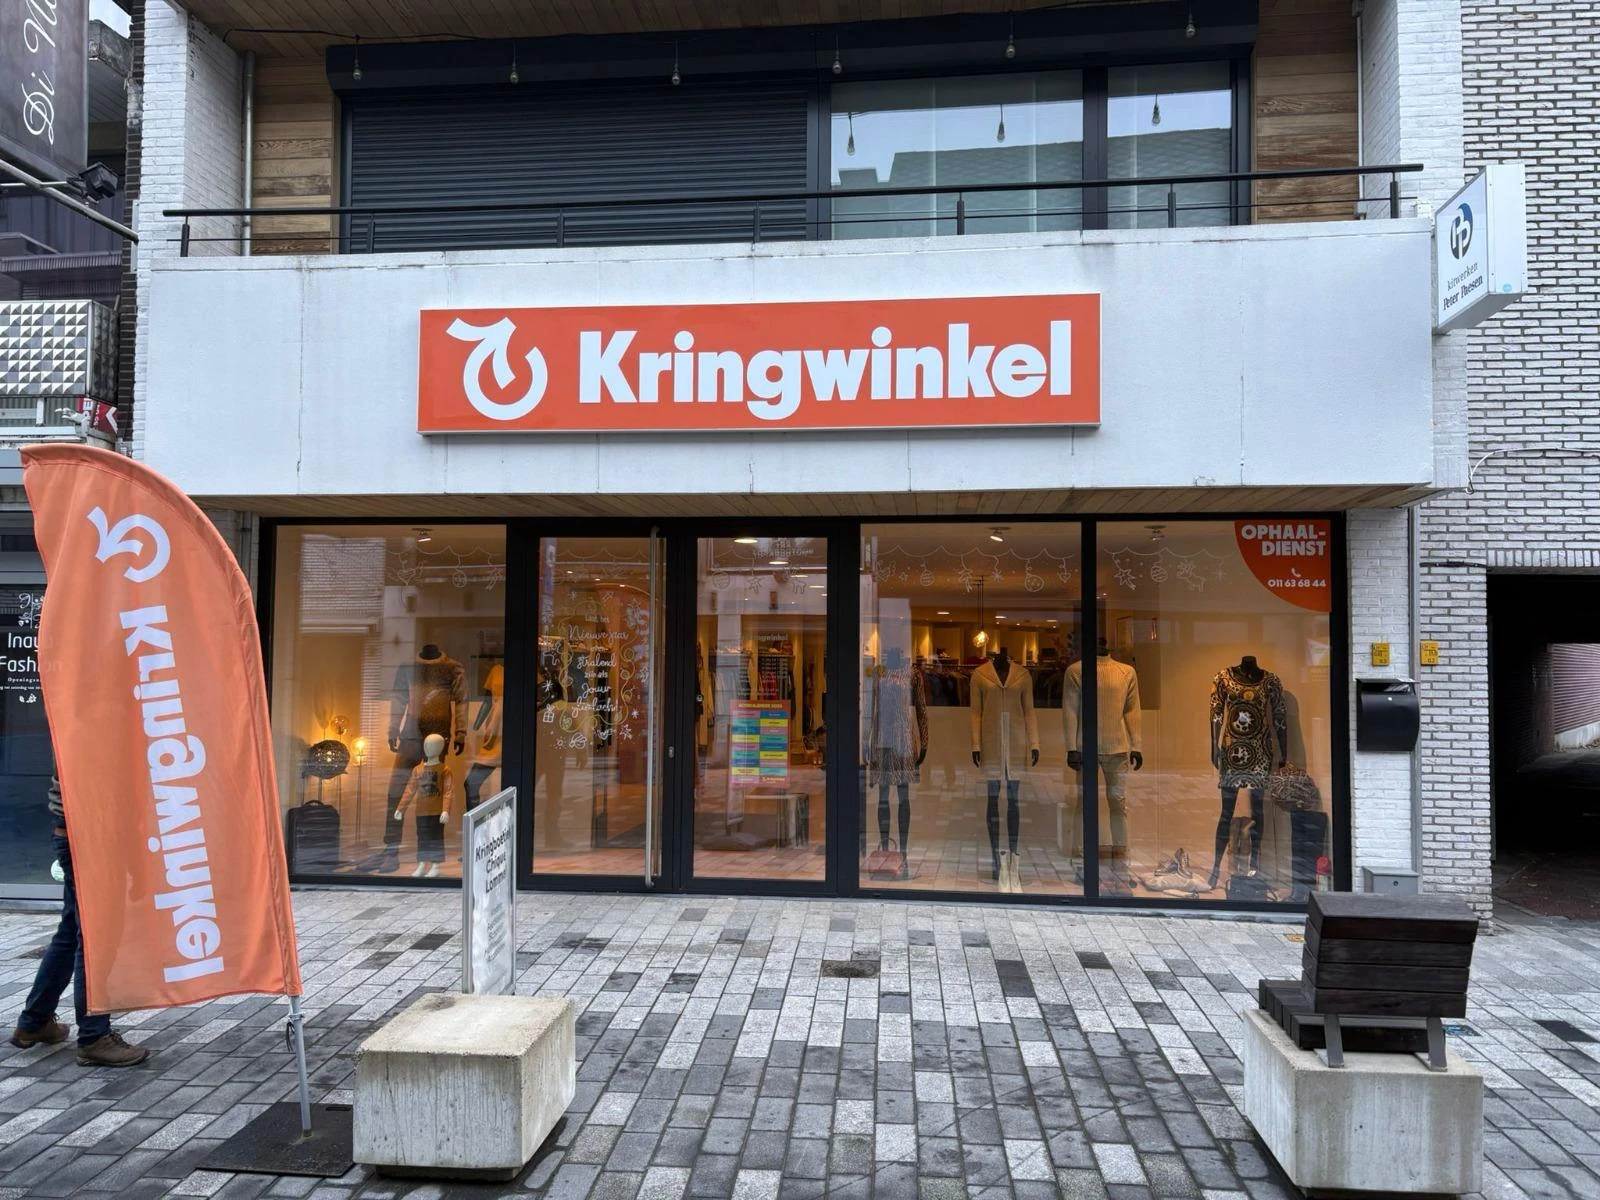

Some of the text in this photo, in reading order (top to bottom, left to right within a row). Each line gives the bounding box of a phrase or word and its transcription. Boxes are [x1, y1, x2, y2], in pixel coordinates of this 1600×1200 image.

[21, 70, 55, 145] Di
[1443, 291, 1460, 311] Peter
[580, 320, 1072, 421] Kringwinkel
[1241, 524, 1326, 541] OPHAAL-
[1261, 541, 1326, 557] DIENST
[1284, 579, 1297, 588] 63
[1298, 579, 1311, 588] 68
[1312, 579, 1326, 588] 44
[0, 655, 42, 673] Fash
